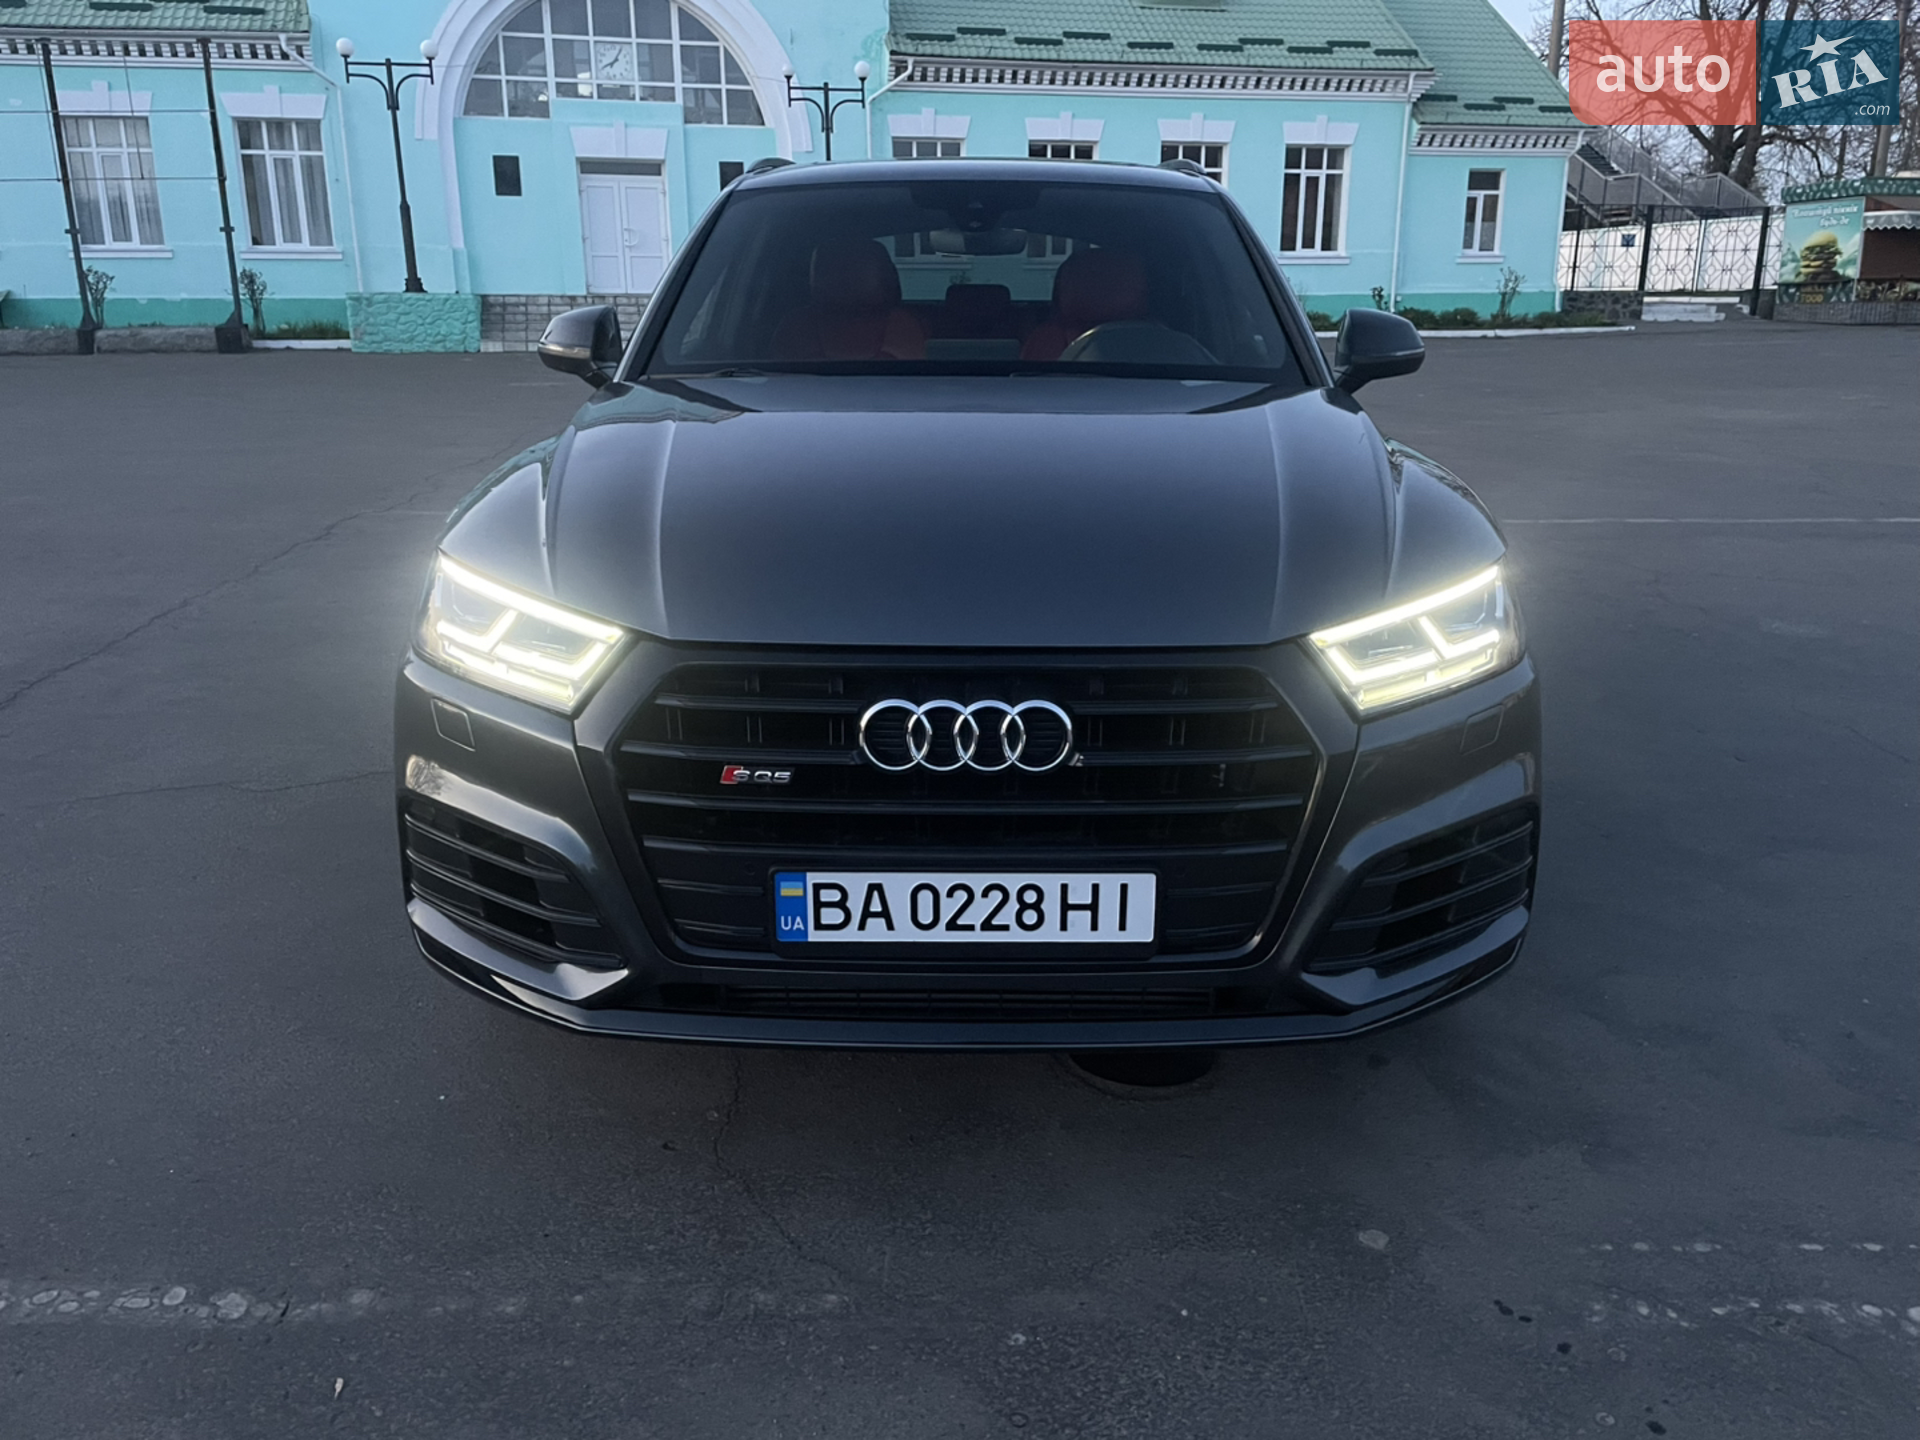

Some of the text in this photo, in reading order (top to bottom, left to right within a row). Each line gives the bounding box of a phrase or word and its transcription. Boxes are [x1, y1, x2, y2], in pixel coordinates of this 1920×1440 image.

[731, 769, 792, 784] SQ5
[811, 882, 1129, 931] BA 0228 HI
[780, 915, 805, 931] UA
